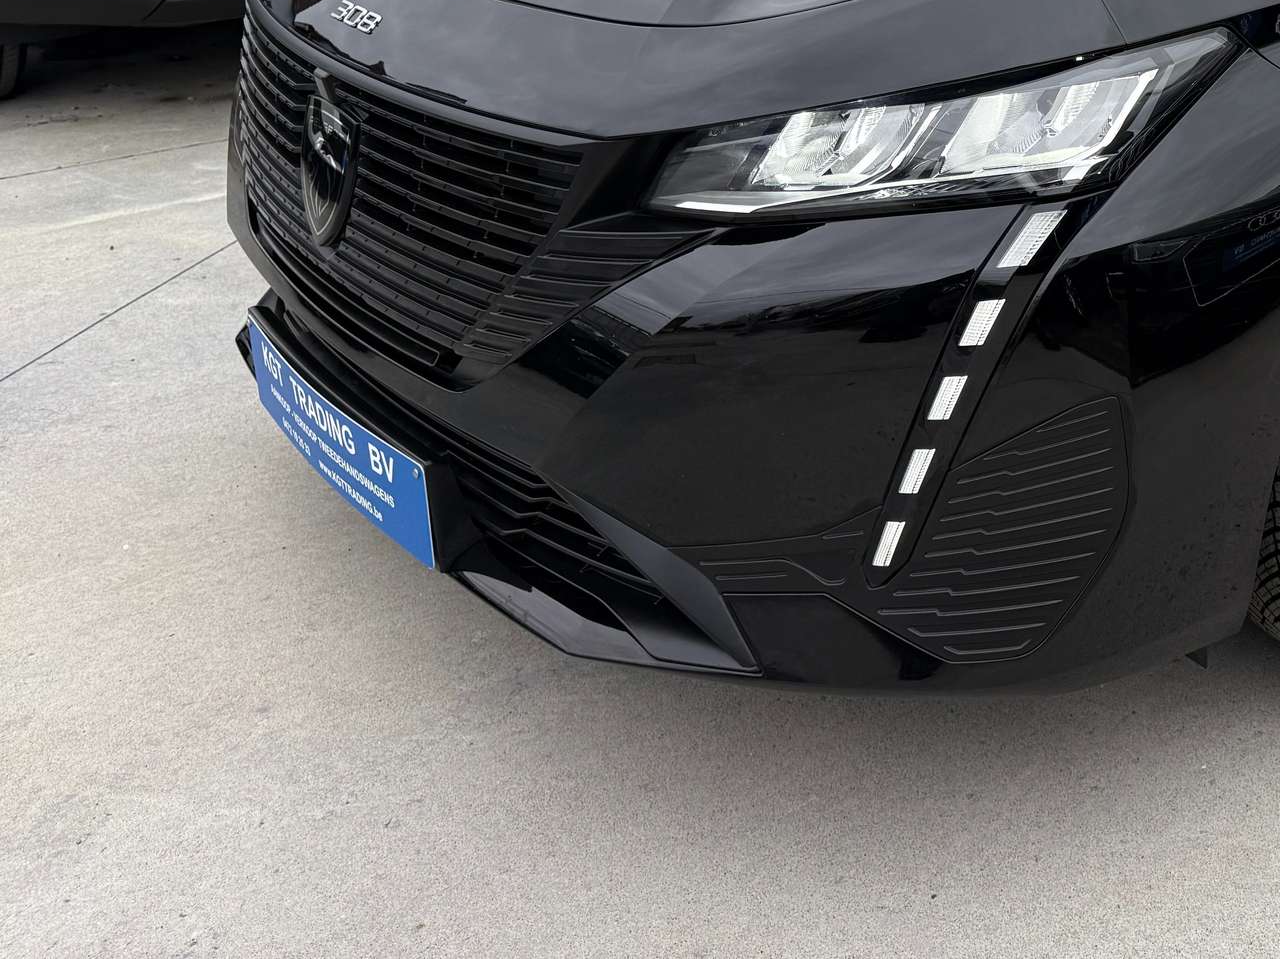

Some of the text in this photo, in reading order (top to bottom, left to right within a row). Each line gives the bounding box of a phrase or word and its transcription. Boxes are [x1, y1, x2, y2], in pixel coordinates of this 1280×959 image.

[330, 0, 382, 34] 308
[261, 340, 284, 387] KGT
[289, 375, 356, 455] TRADING
[367, 442, 394, 483] BV
